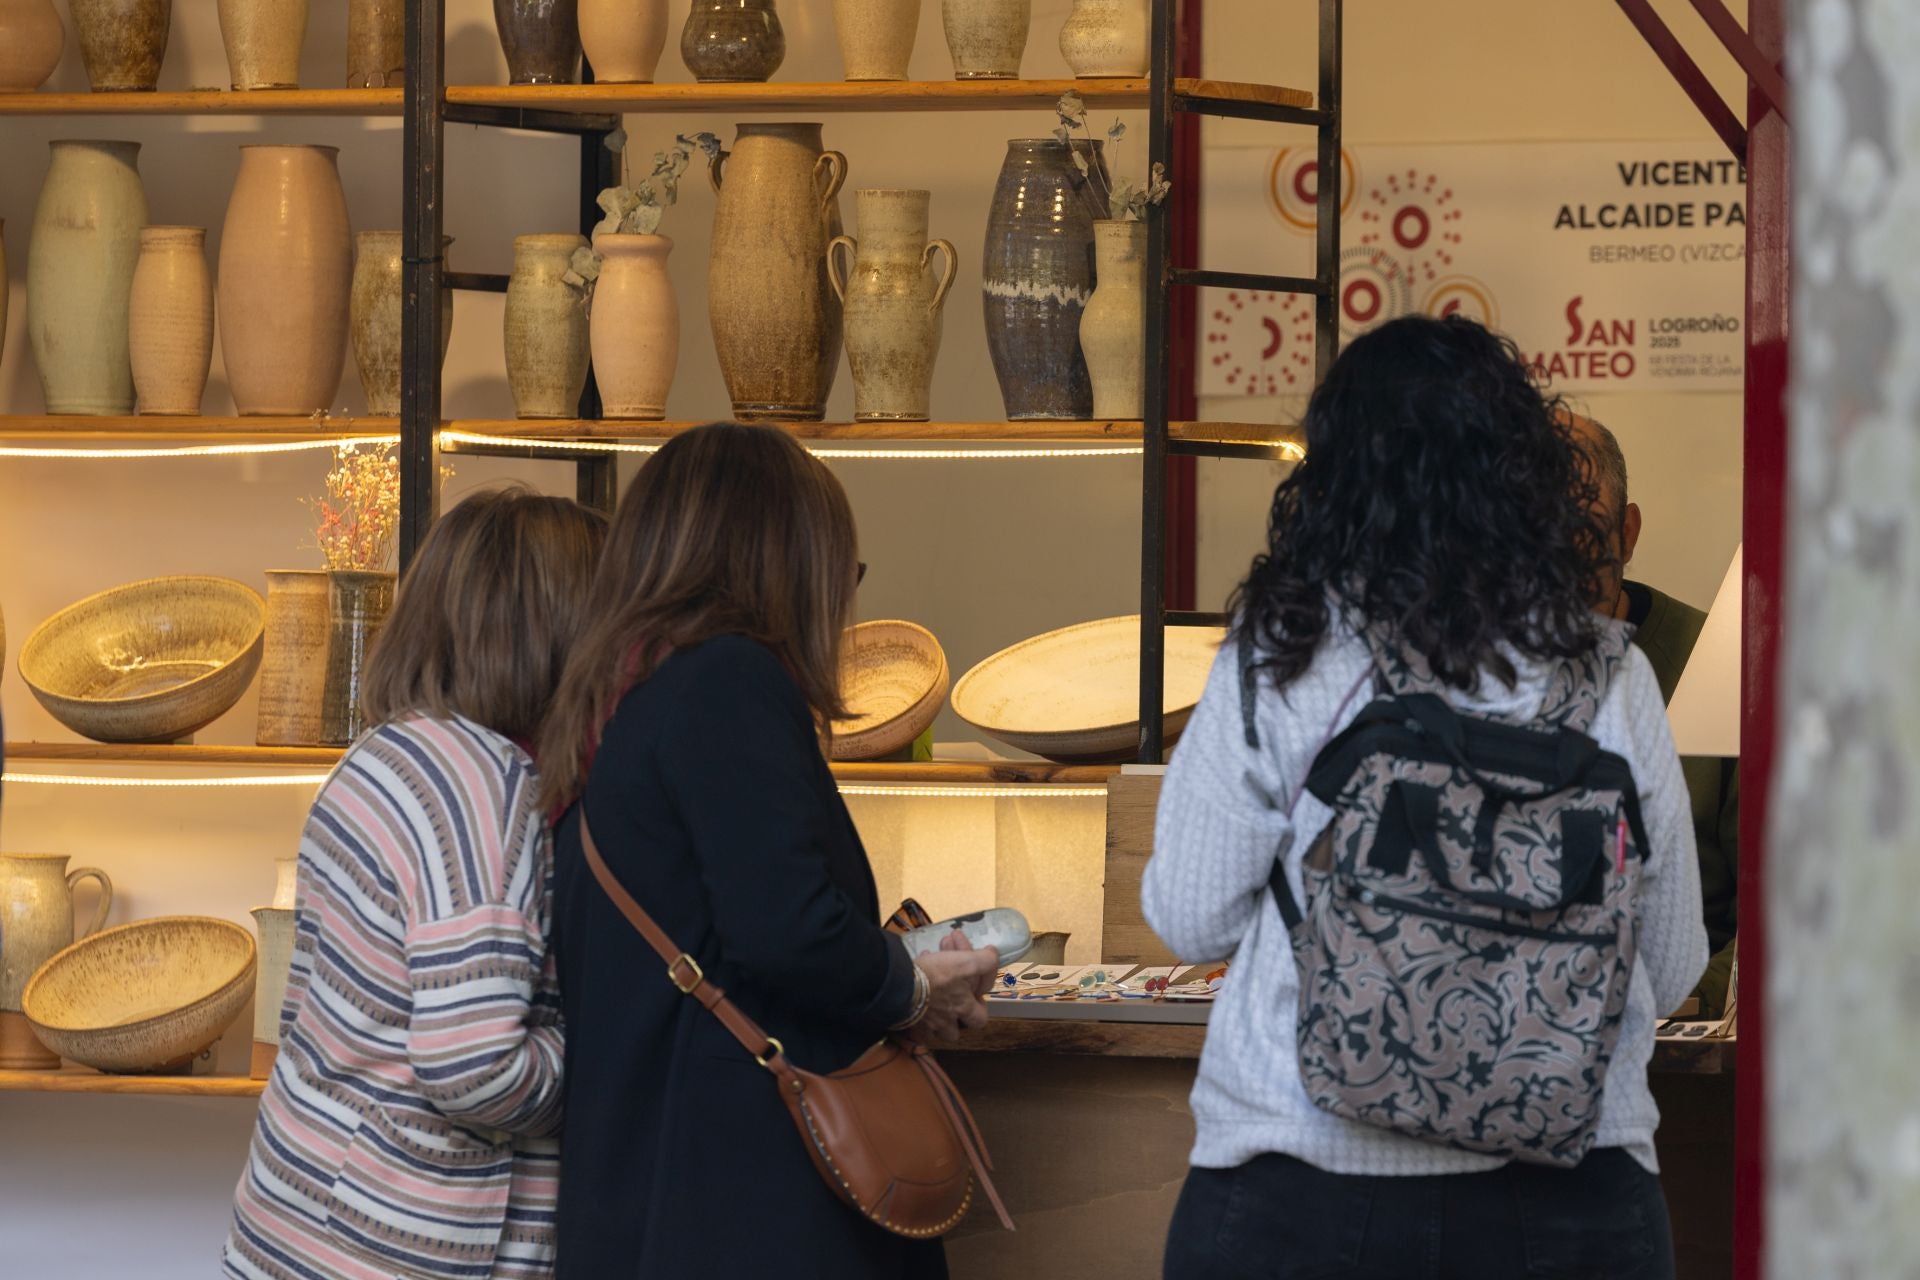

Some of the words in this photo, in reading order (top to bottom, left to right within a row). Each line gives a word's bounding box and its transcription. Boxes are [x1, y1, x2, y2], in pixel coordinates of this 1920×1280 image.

[1554, 203, 1694, 229] ALCAIDE
[1705, 202, 1746, 227] PA
[1589, 245, 1675, 263] BERMEO
[1565, 296, 1635, 346] SAN
[1649, 313, 1739, 333] LOGROÑO
